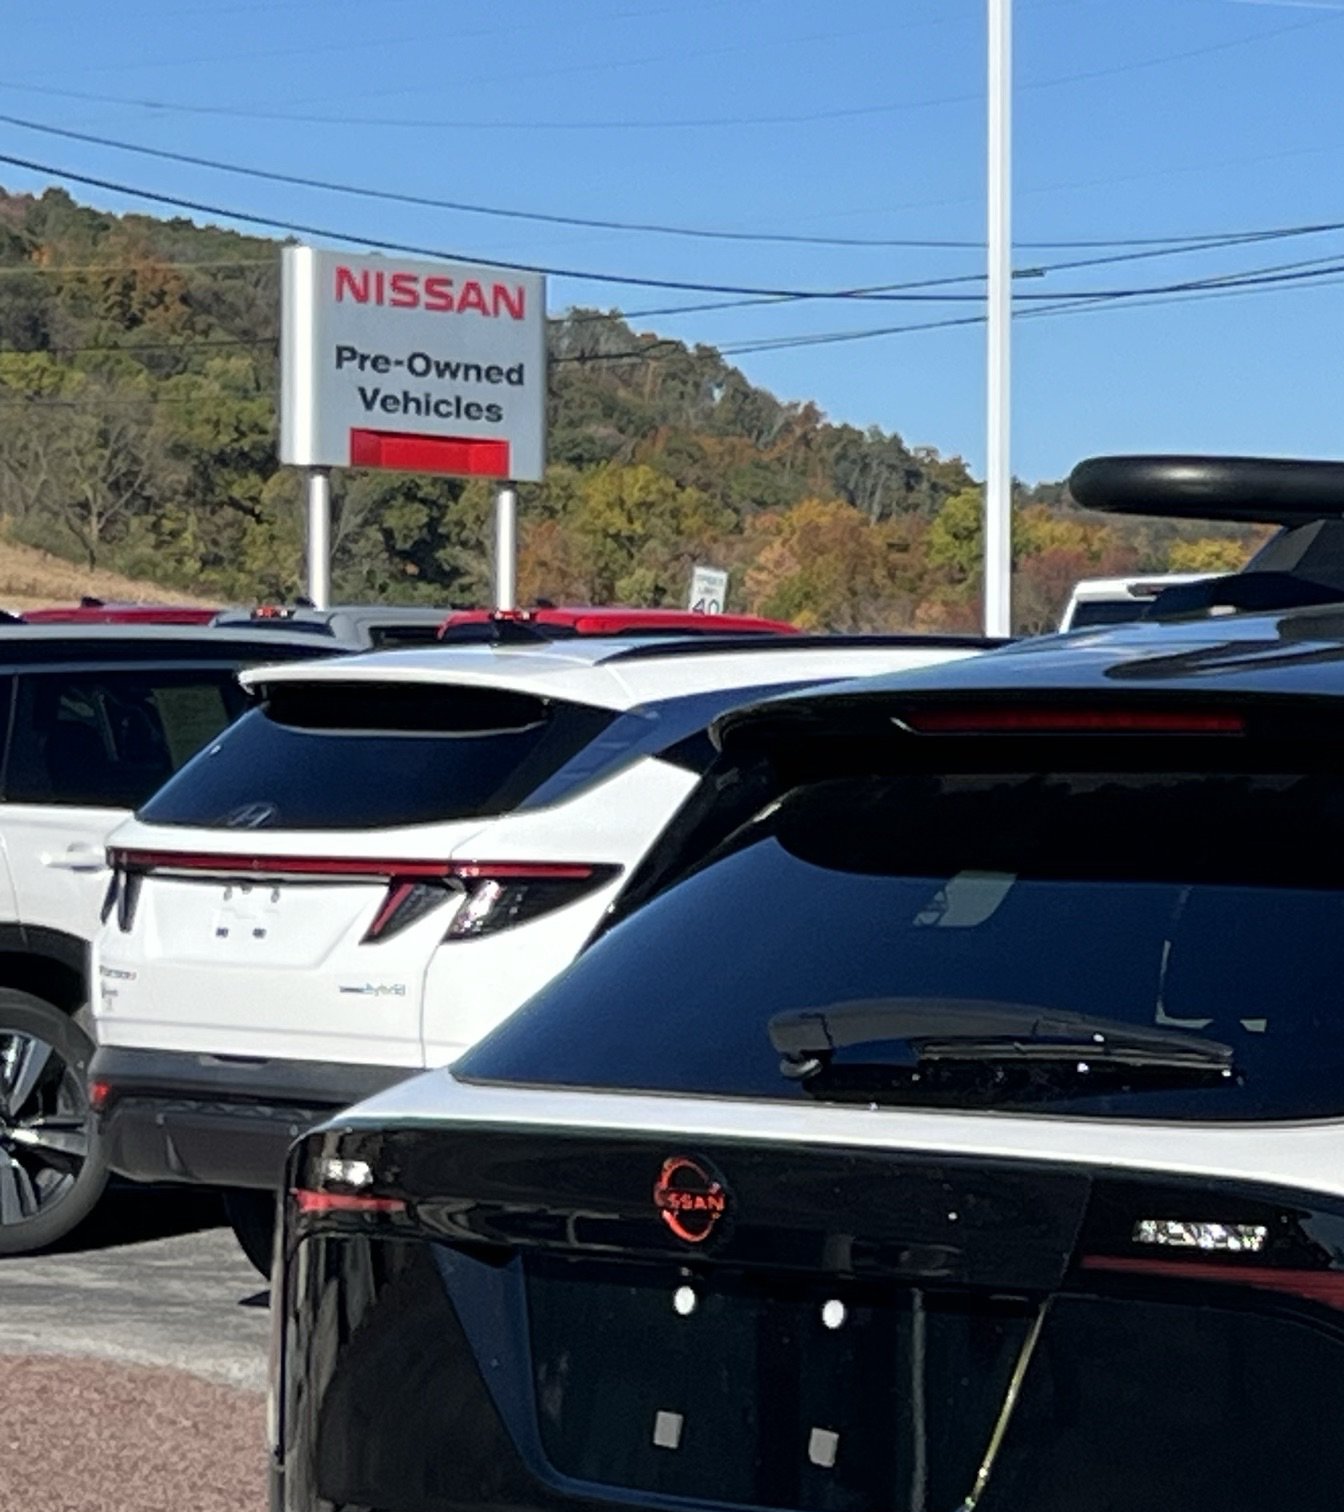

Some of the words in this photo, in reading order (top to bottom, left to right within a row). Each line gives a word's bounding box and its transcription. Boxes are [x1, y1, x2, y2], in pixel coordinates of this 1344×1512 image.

[335, 266, 524, 320] NISSAN
[335, 345, 524, 385] Pre-Owned
[358, 387, 503, 422] Vehicles
